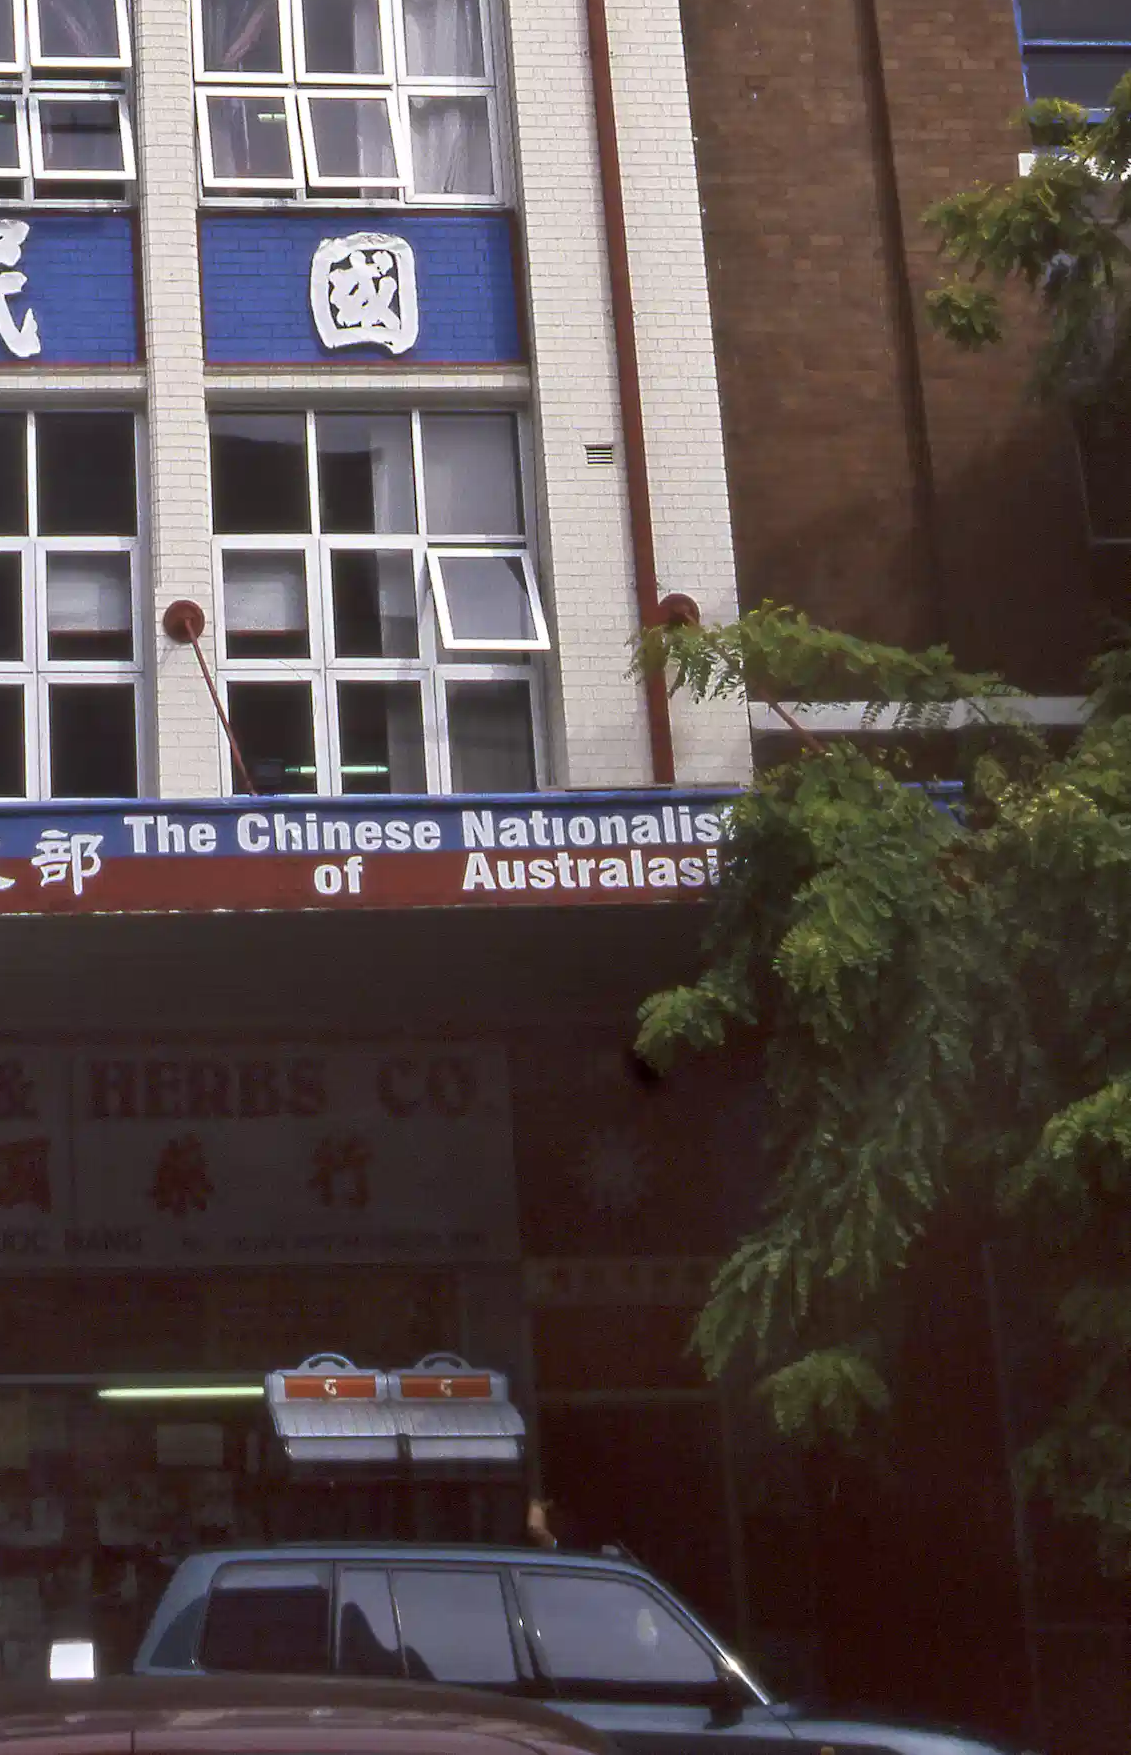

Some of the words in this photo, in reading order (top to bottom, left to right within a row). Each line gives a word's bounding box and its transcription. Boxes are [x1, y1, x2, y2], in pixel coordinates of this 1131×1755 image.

[123, 814, 217, 854] The
[237, 811, 442, 852] Chinese
[313, 855, 364, 894] of
[462, 848, 722, 891] Australasi
[86, 1058, 329, 1121] HERBS
